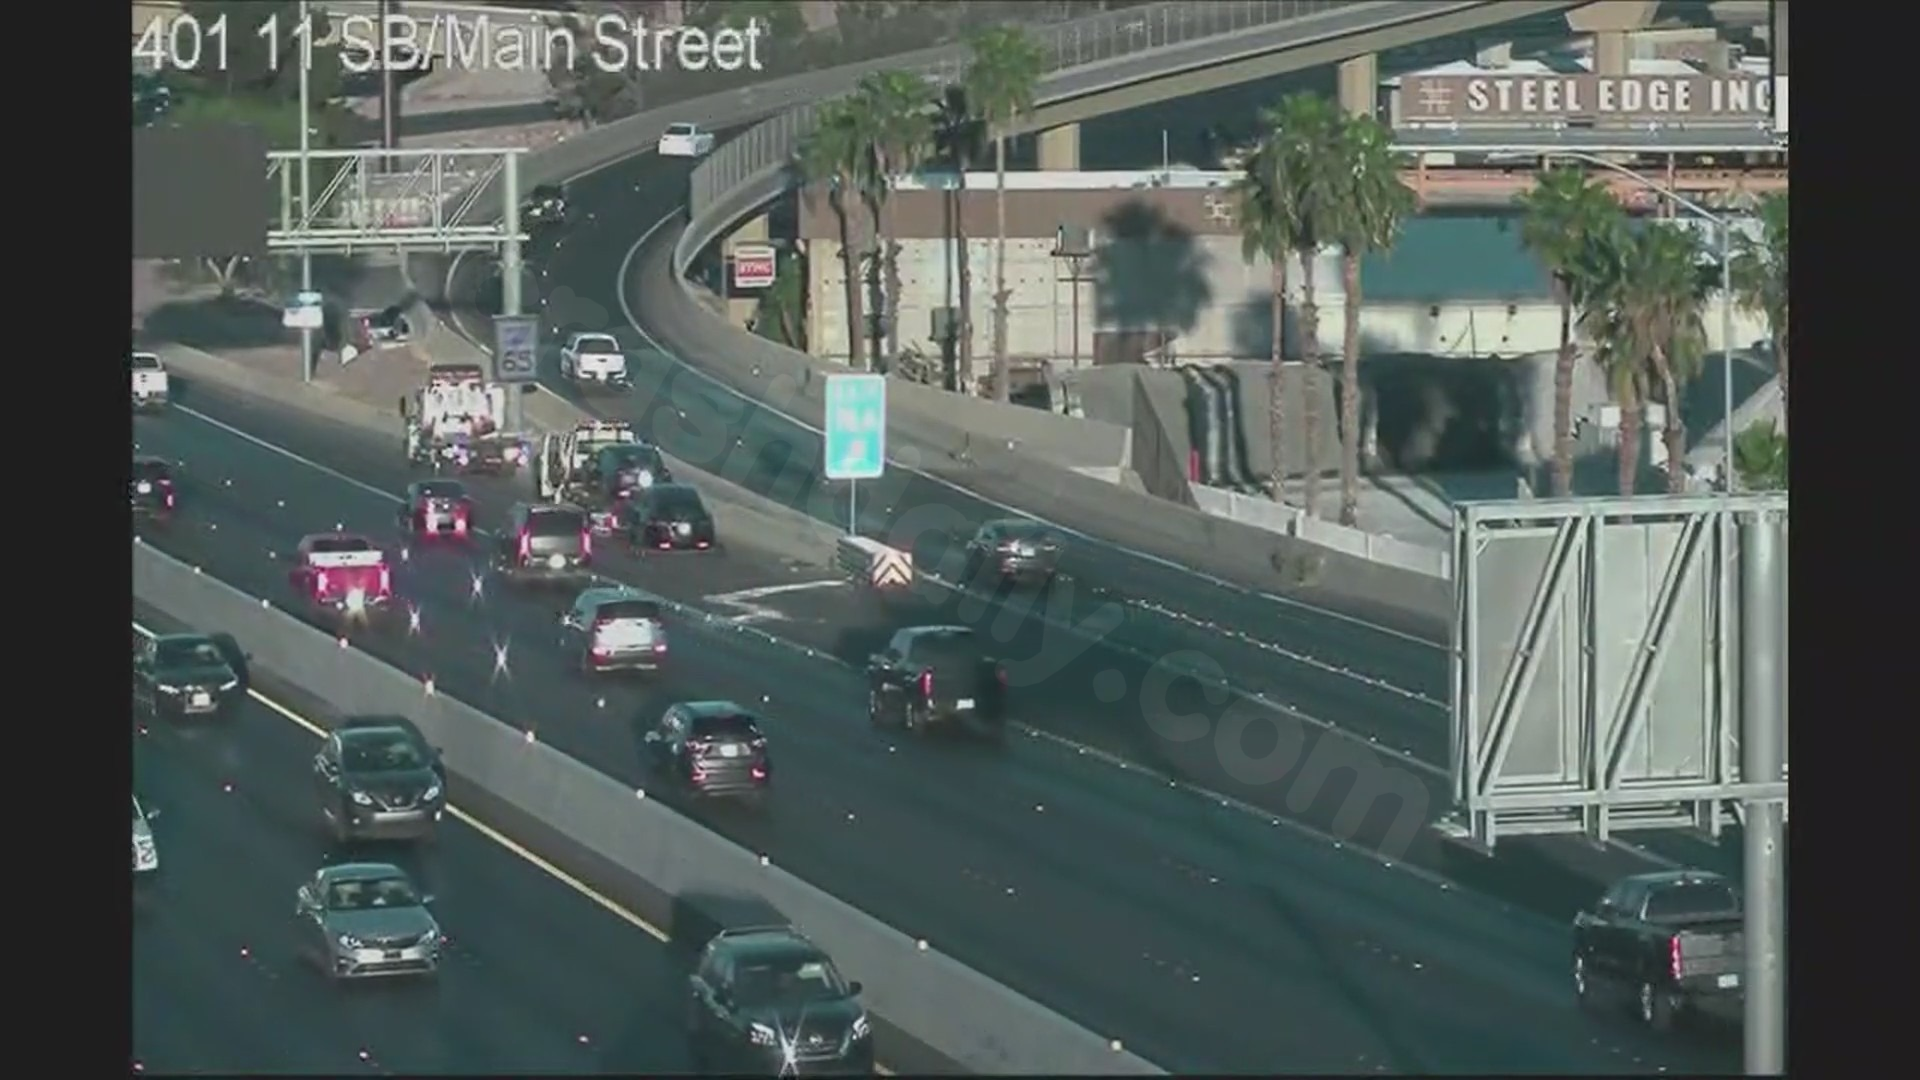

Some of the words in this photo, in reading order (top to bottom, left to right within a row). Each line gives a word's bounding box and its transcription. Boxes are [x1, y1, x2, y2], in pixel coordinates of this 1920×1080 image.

[1467, 79, 1582, 112] STEEL
[1599, 79, 1691, 112] EDGE
[1711, 79, 1770, 113] INC
[502, 350, 533, 373] 65
